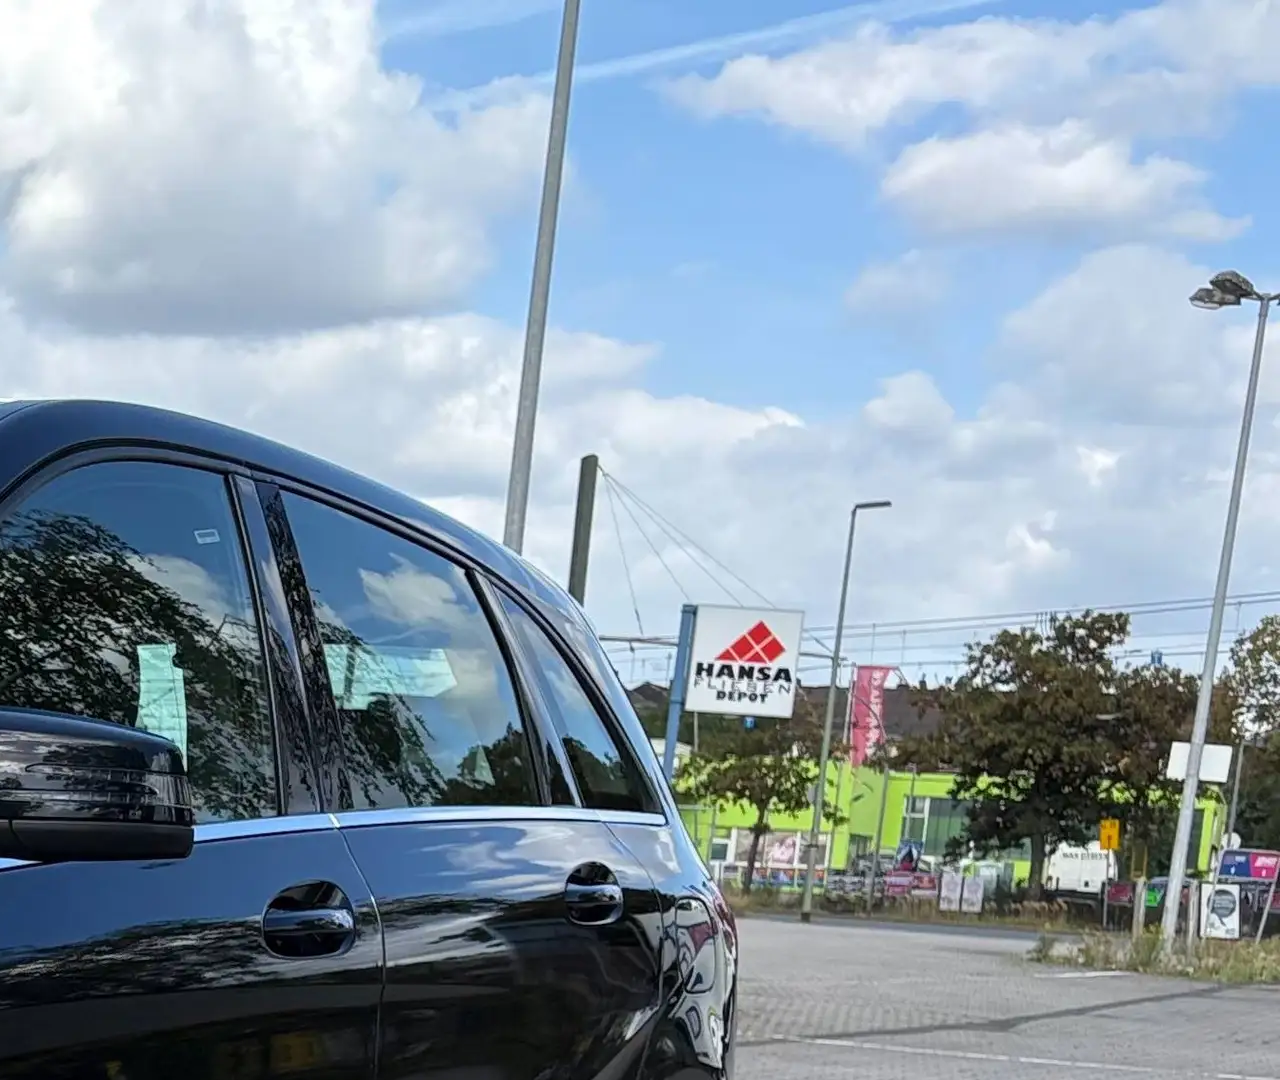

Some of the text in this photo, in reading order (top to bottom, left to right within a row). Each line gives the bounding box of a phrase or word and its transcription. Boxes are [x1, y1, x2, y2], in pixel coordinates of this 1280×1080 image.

[695, 662, 792, 682] HANSA
[694, 675, 791, 694] FLIESEN
[716, 690, 768, 703] DEPOT
